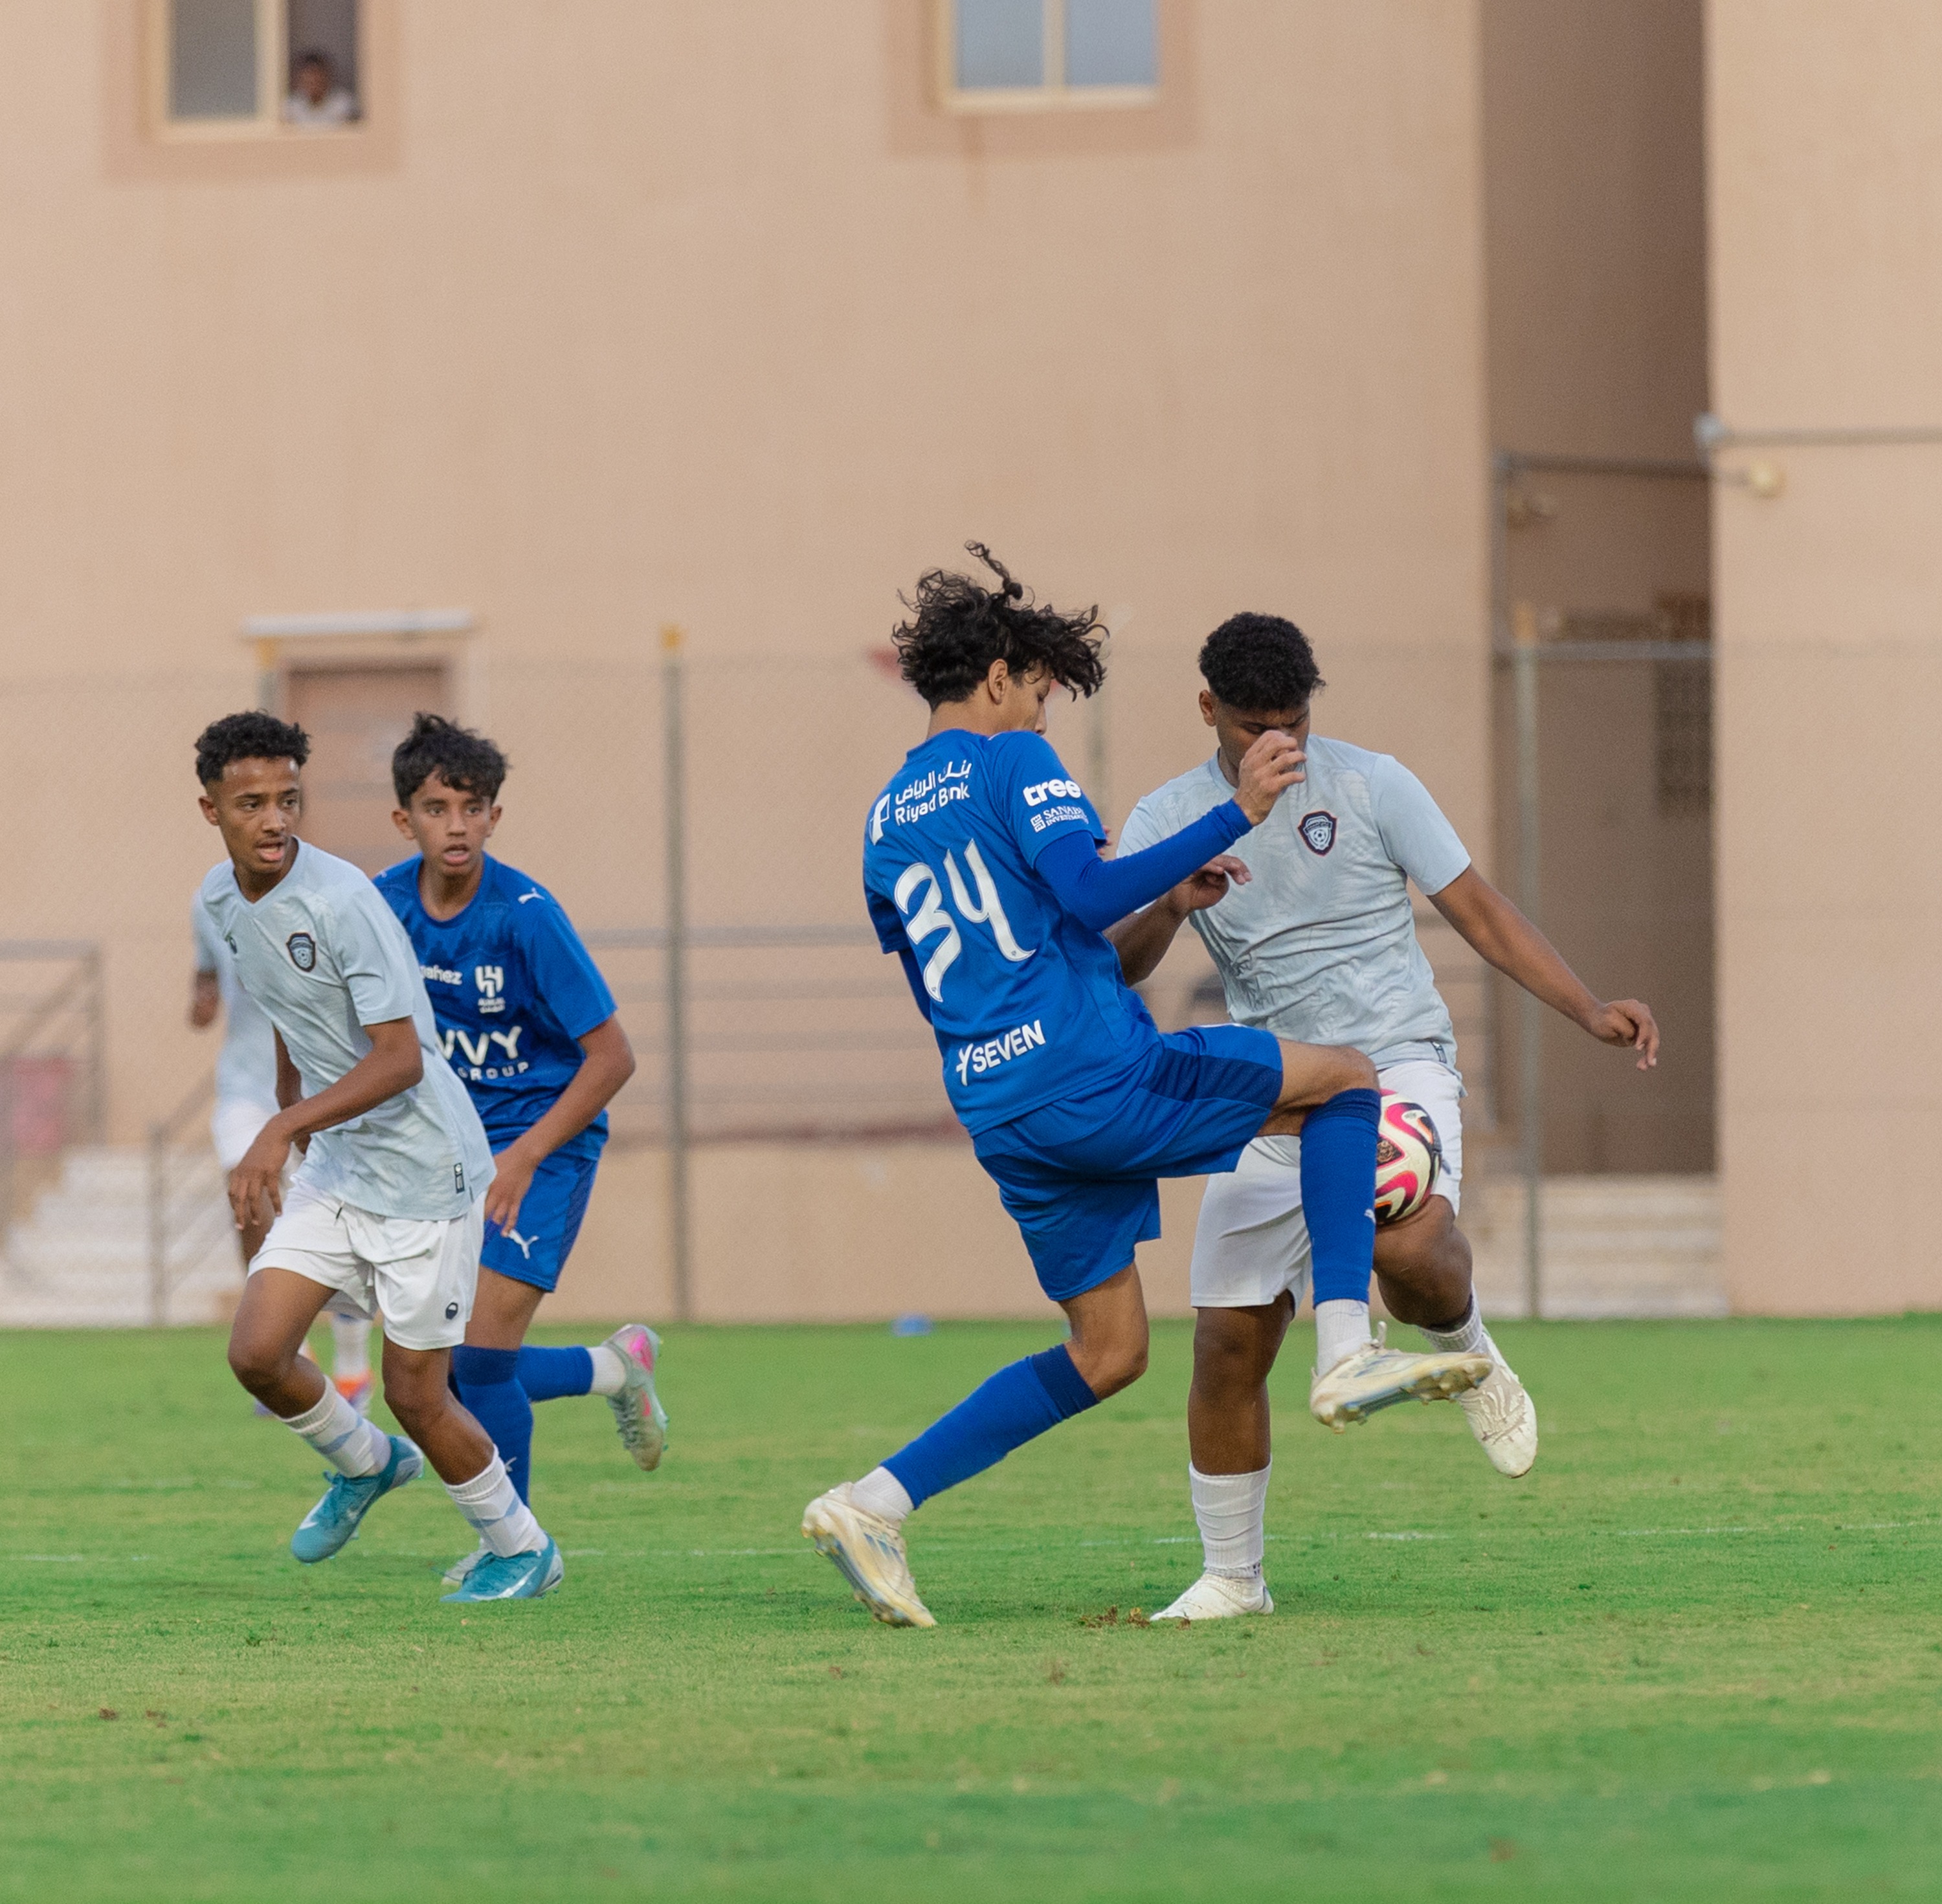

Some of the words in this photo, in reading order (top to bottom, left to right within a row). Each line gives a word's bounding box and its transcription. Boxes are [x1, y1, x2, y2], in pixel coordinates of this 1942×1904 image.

[895, 770, 936, 805] الرياض
[895, 793, 936, 826] Riyad
[939, 781, 970, 808] Bnk
[1023, 779, 1082, 807] tree
[894, 837, 1036, 1003] 34
[434, 1025, 522, 1066] VVY
